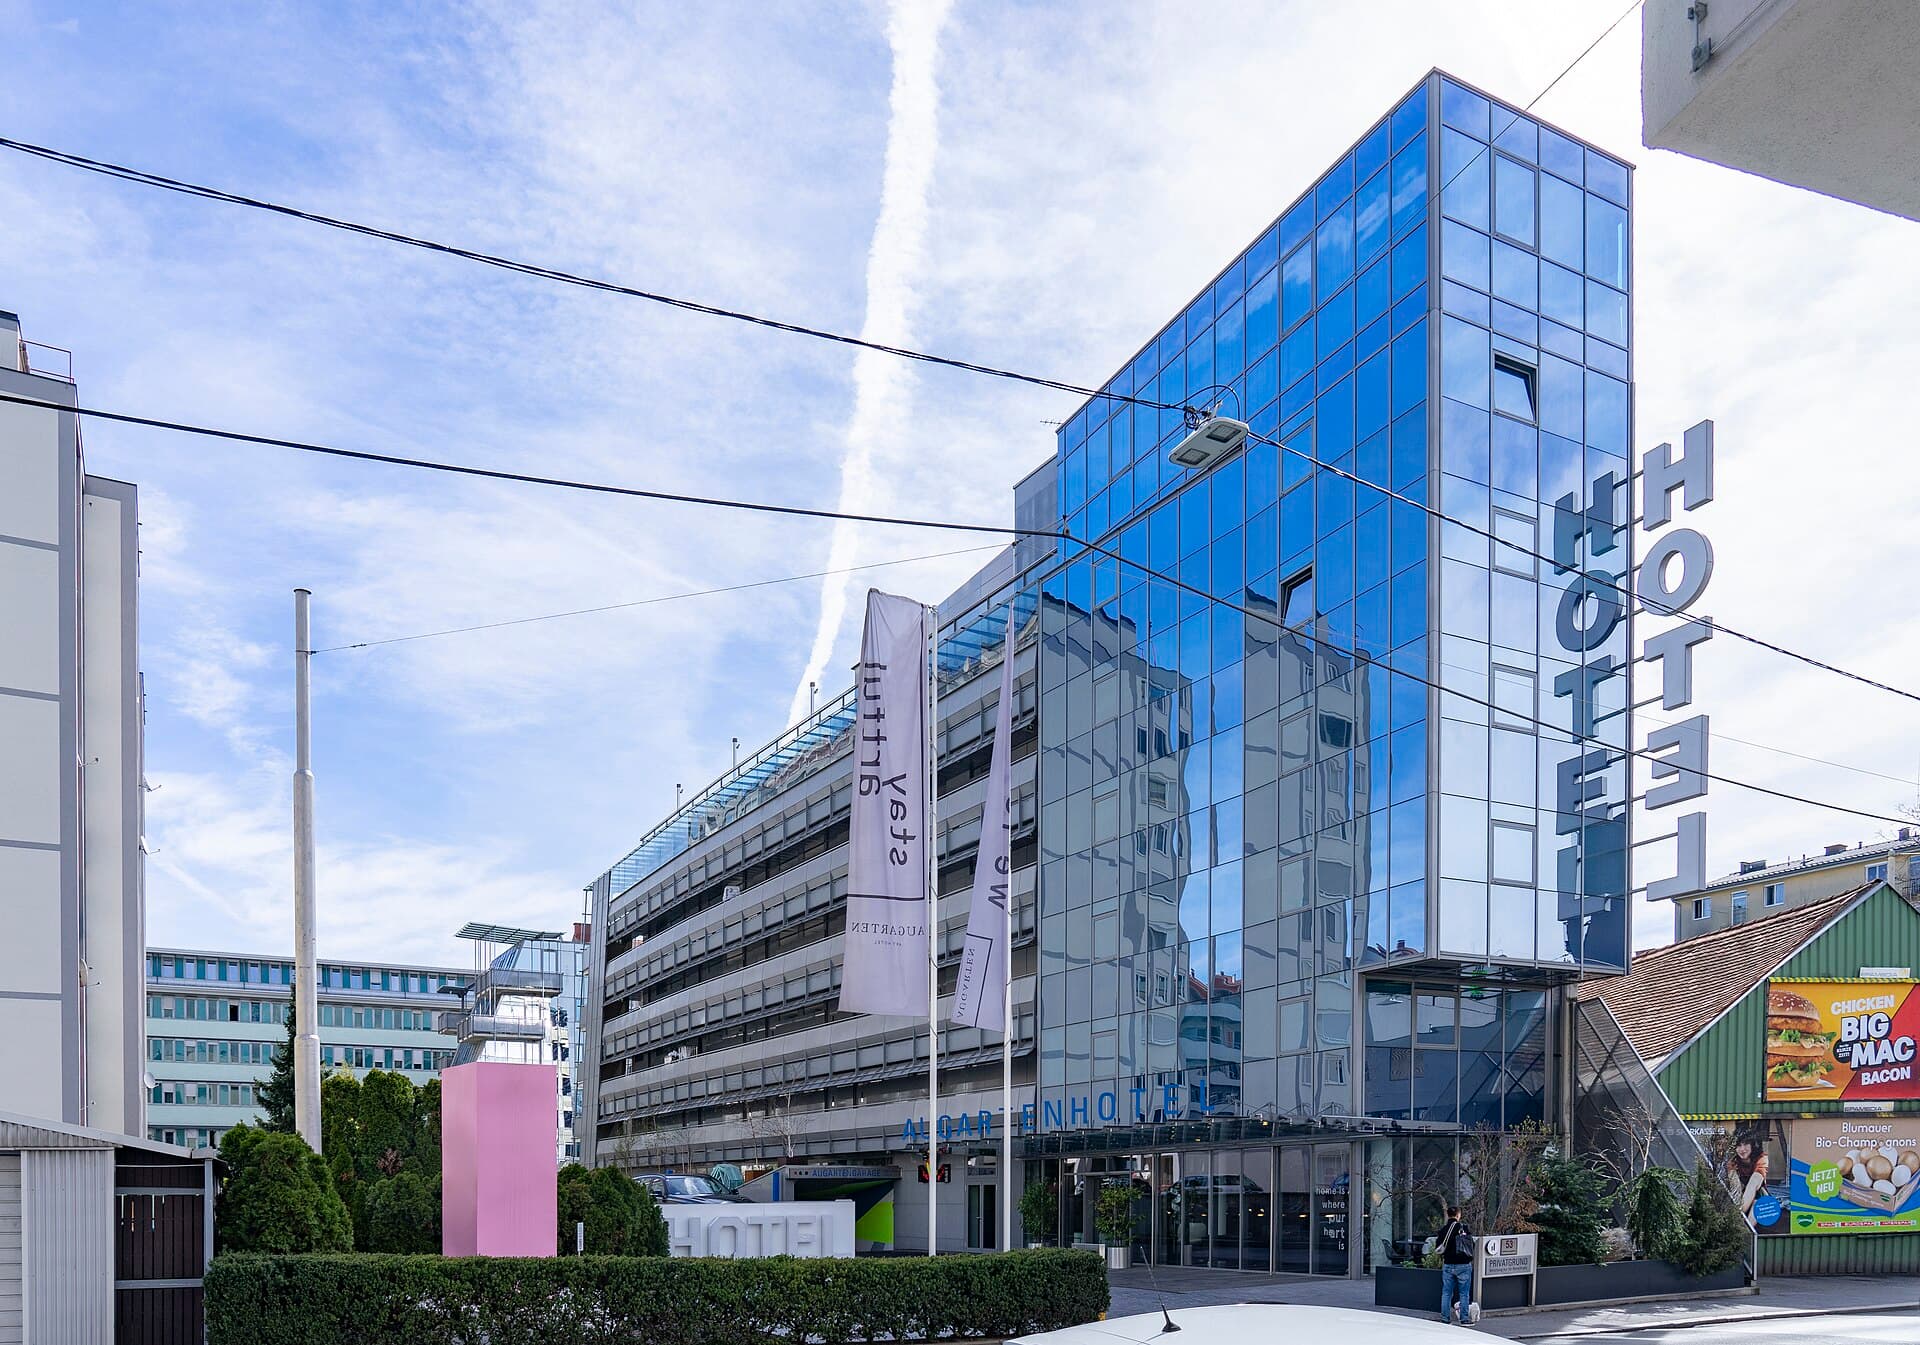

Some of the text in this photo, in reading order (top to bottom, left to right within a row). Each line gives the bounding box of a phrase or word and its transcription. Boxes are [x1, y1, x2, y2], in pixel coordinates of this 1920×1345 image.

[1831, 995, 1895, 1015] CHICKEN
[1842, 1012, 1890, 1042] BIG
[1851, 1036, 1915, 1069] MAC
[1861, 1066, 1911, 1086] BACON
[901, 1079, 1215, 1141] AUGARENHOTEL
[1842, 1122, 1893, 1133] Blumauer
[1816, 1136, 1917, 1150] Bio-Champgnons
[1809, 1168, 1838, 1183] JETZT
[1816, 1181, 1835, 1195] NEU
[1321, 1200, 1345, 1209] where
[1505, 1240, 1514, 1249] 53
